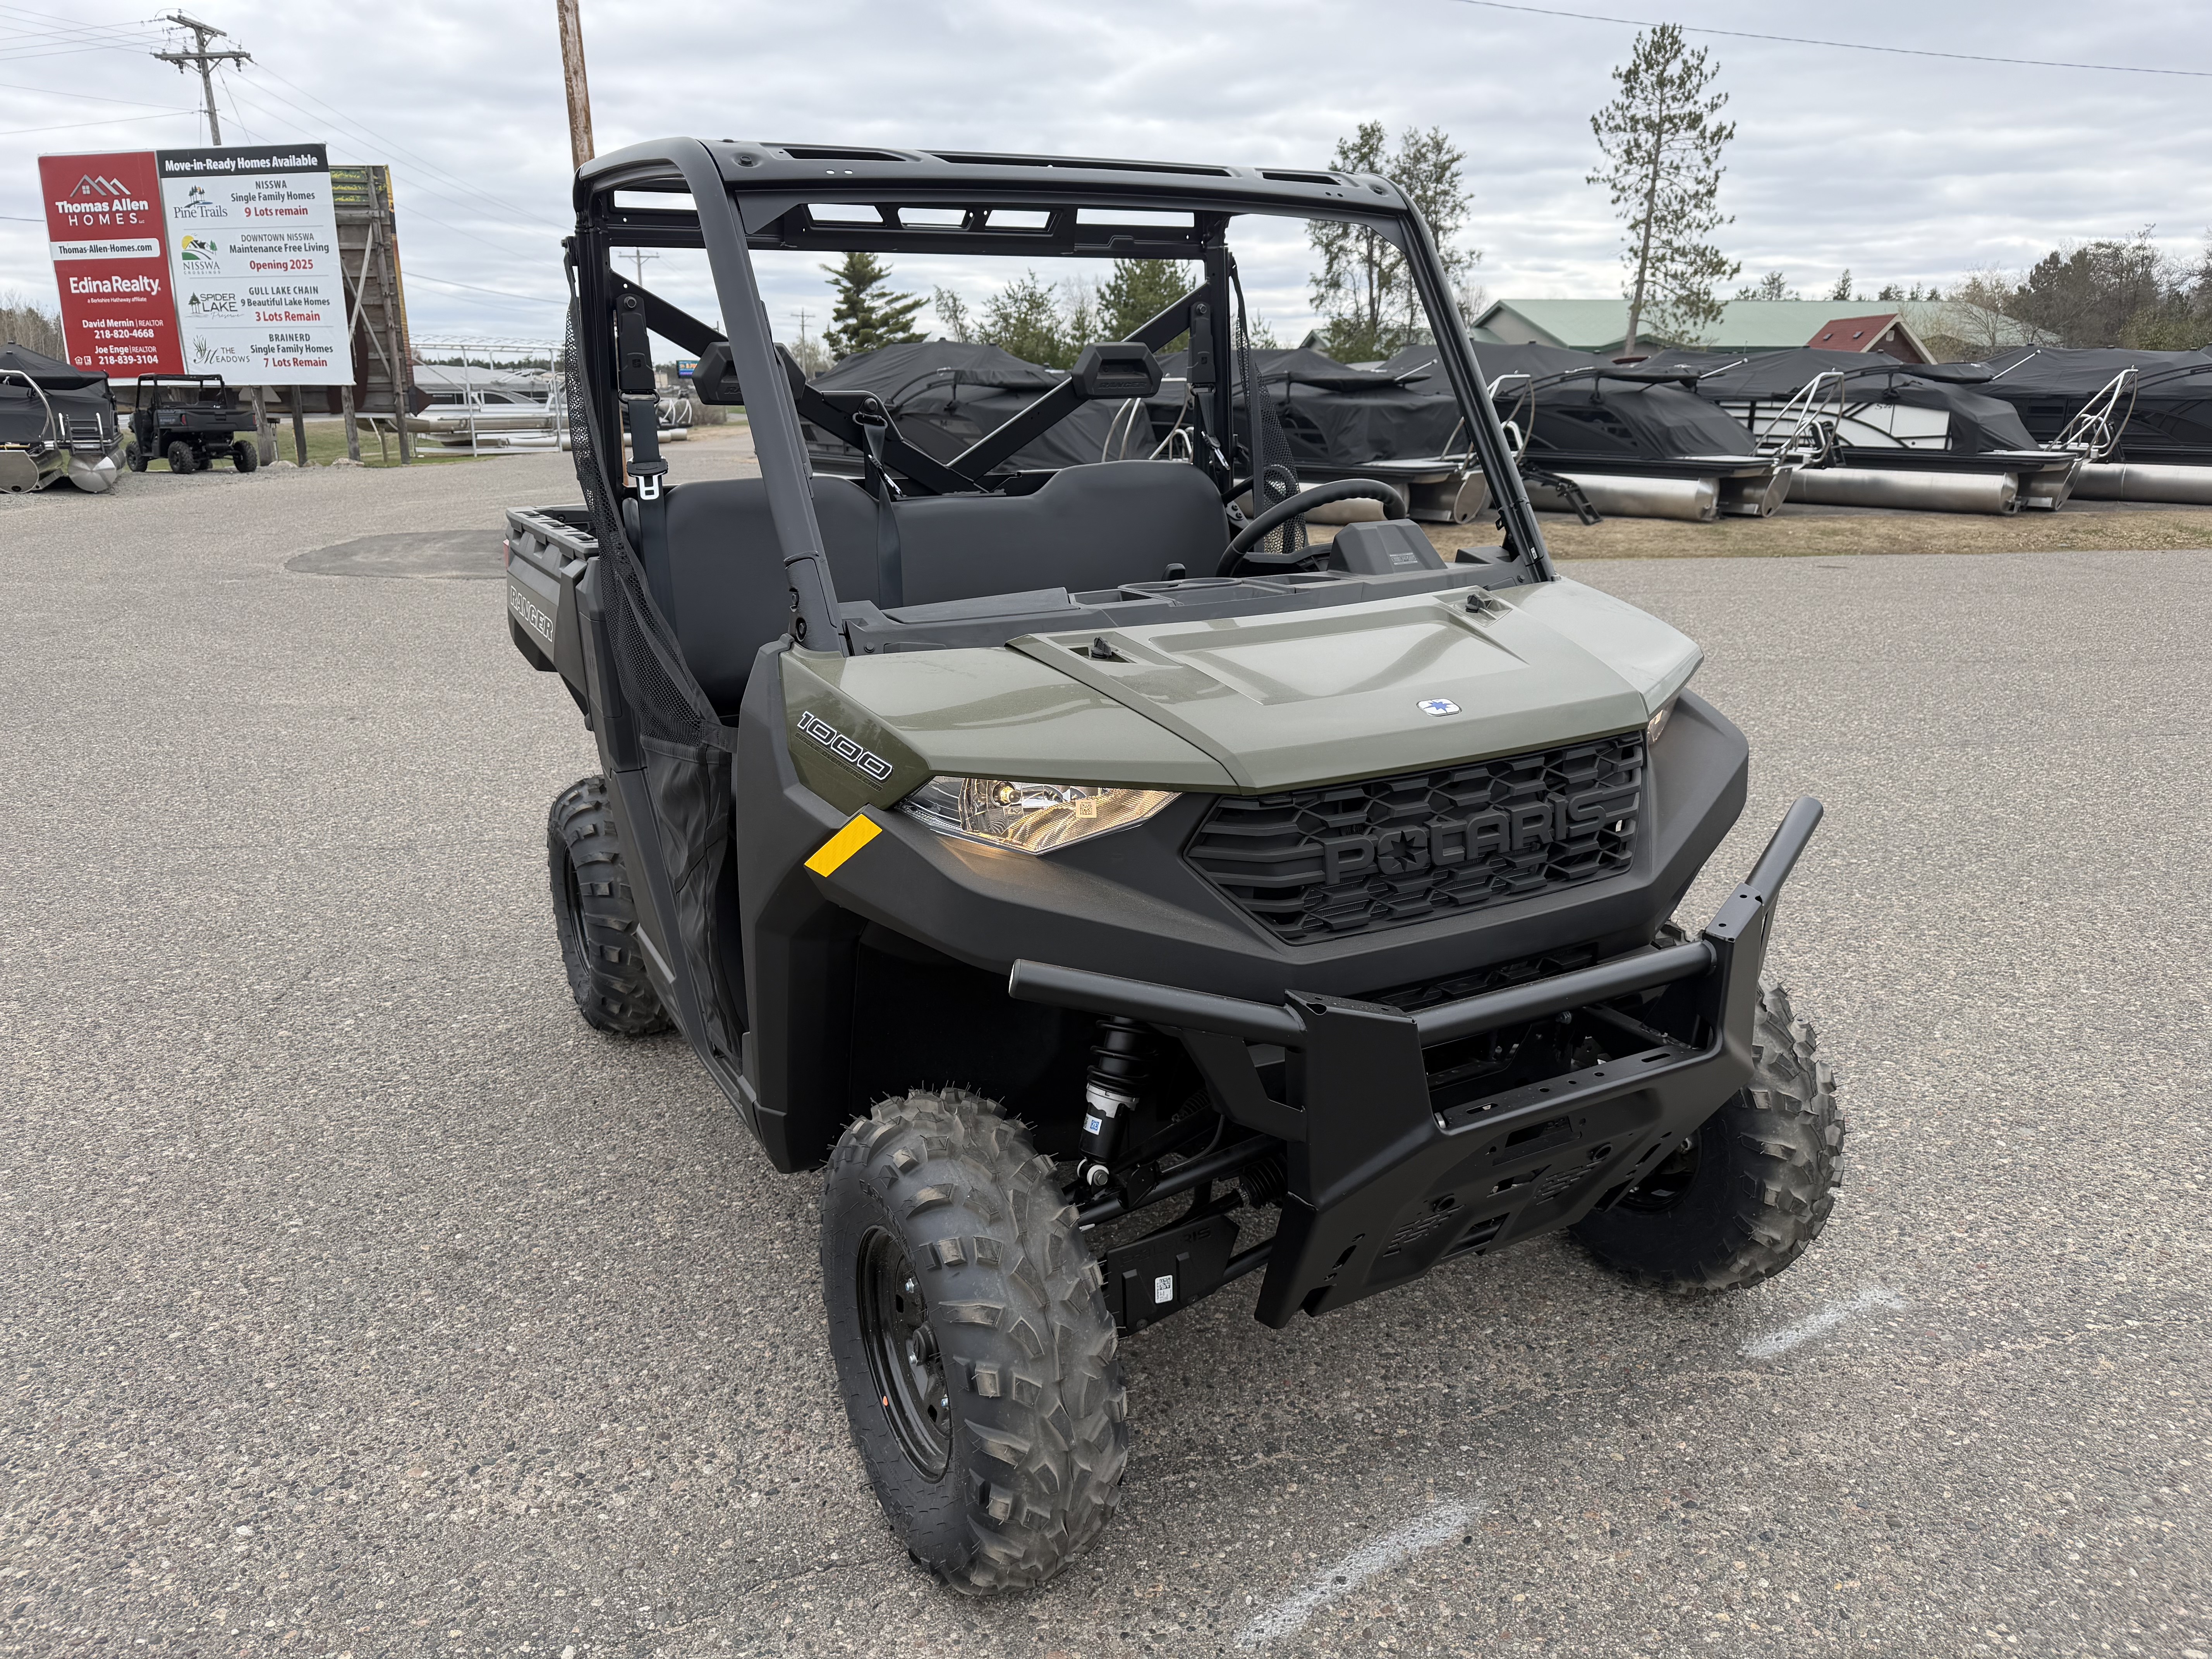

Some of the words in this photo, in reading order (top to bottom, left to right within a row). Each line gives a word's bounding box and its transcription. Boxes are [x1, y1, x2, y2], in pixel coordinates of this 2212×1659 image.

[165, 158, 236, 172] Move-in-Ready
[237, 157, 271, 168] Homes
[272, 154, 318, 167] Available
[255, 180, 287, 189] NISSWA
[231, 192, 256, 204] Single
[258, 191, 285, 203] Family
[287, 191, 315, 200] Homes
[55, 201, 109, 213] Thomas
[112, 198, 148, 211] Allen
[244, 207, 251, 217] 9
[254, 207, 273, 216] Lots
[275, 205, 308, 216] remain
[173, 206, 197, 218] Pine
[197, 205, 228, 217] Trails
[69, 213, 137, 226] HOMES
[287, 233, 314, 241] NISSWA
[58, 244, 152, 254] Thomas-Allen-Homes.com
[230, 244, 282, 253] Maintenance
[284, 243, 302, 252] Free
[304, 242, 329, 253] Living
[183, 261, 220, 270] NISSWA
[249, 259, 288, 272] Opening
[290, 259, 313, 269] 2025
[249, 287, 269, 295] GULL
[271, 286, 291, 295] LAKE
[293, 286, 318, 294] CHAIN
[202, 302, 238, 312] LAKE
[241, 299, 245, 307] 9
[247, 297, 283, 306] Beautiful
[284, 297, 302, 306] Lake
[304, 297, 330, 306] Homes
[255, 311, 261, 321] 3
[263, 311, 283, 321] Lots
[284, 310, 320, 321] Remain
[82, 319, 105, 328] David
[106, 318, 134, 327] Mernin
[94, 329, 154, 339] 218-820-4668
[269, 333, 310, 342] BRAINERD
[95, 345, 108, 354] Joe
[109, 345, 129, 355] Enge
[251, 344, 275, 355] Single
[276, 344, 303, 355] Family
[305, 344, 333, 353] Homes
[98, 355, 158, 365] 218-839-3104
[194, 348, 250, 364] MEADOWS
[263, 358, 268, 368] 7
[272, 357, 291, 367] Lots
[292, 357, 328, 367] Remain
[511, 586, 553, 642] RANGER
[797, 711, 893, 780] 1000
[795, 732, 821, 752] SINGLE
[822, 751, 862, 779] OVERHEAD
[863, 777, 883, 792] CAM
[1321, 789, 1606, 885] POLARIS
